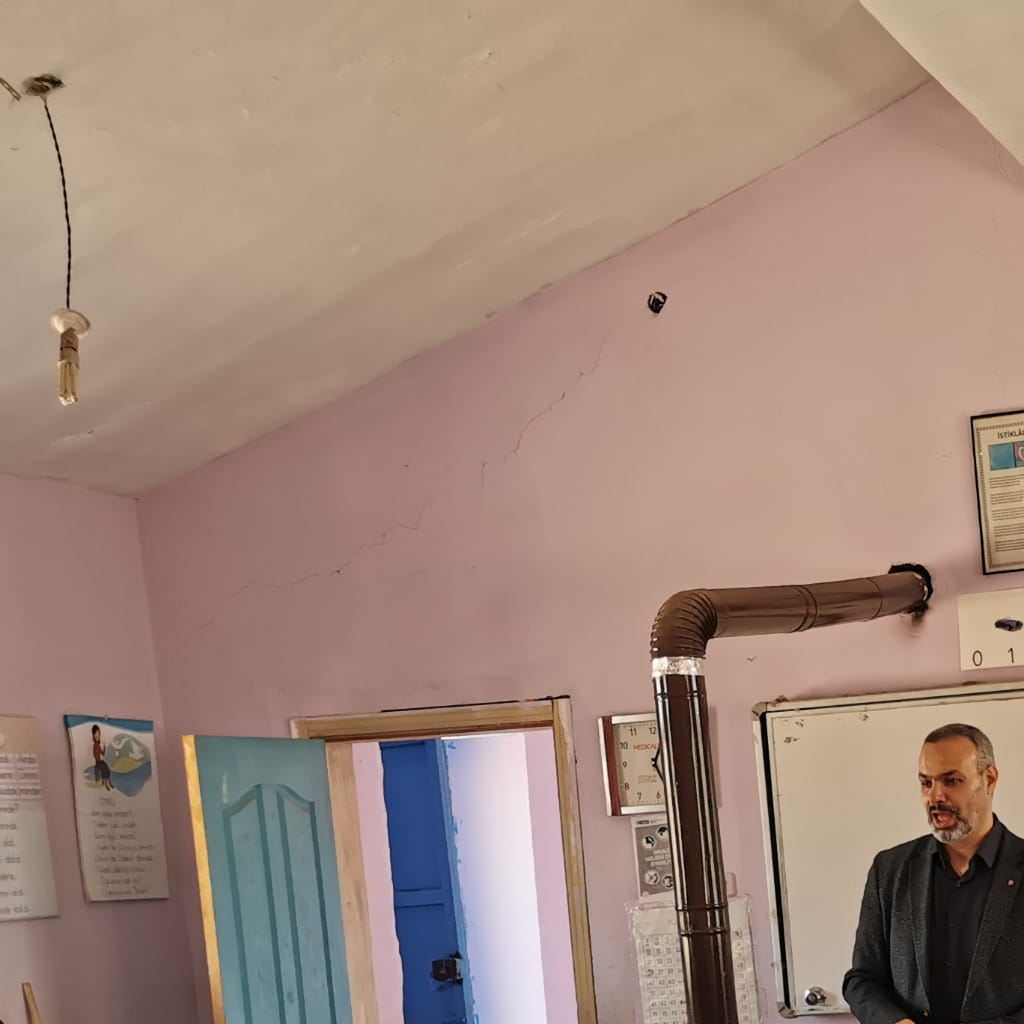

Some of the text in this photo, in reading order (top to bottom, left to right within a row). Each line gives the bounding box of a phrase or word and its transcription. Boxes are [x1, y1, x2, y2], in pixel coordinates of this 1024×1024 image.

[972, 650, 983, 667] 0
[1007, 647, 1015, 664] 1
[629, 727, 657, 736] 11 12
[620, 742, 628, 750] 10
[624, 782, 630, 790] 8
[637, 792, 642, 800] 7
